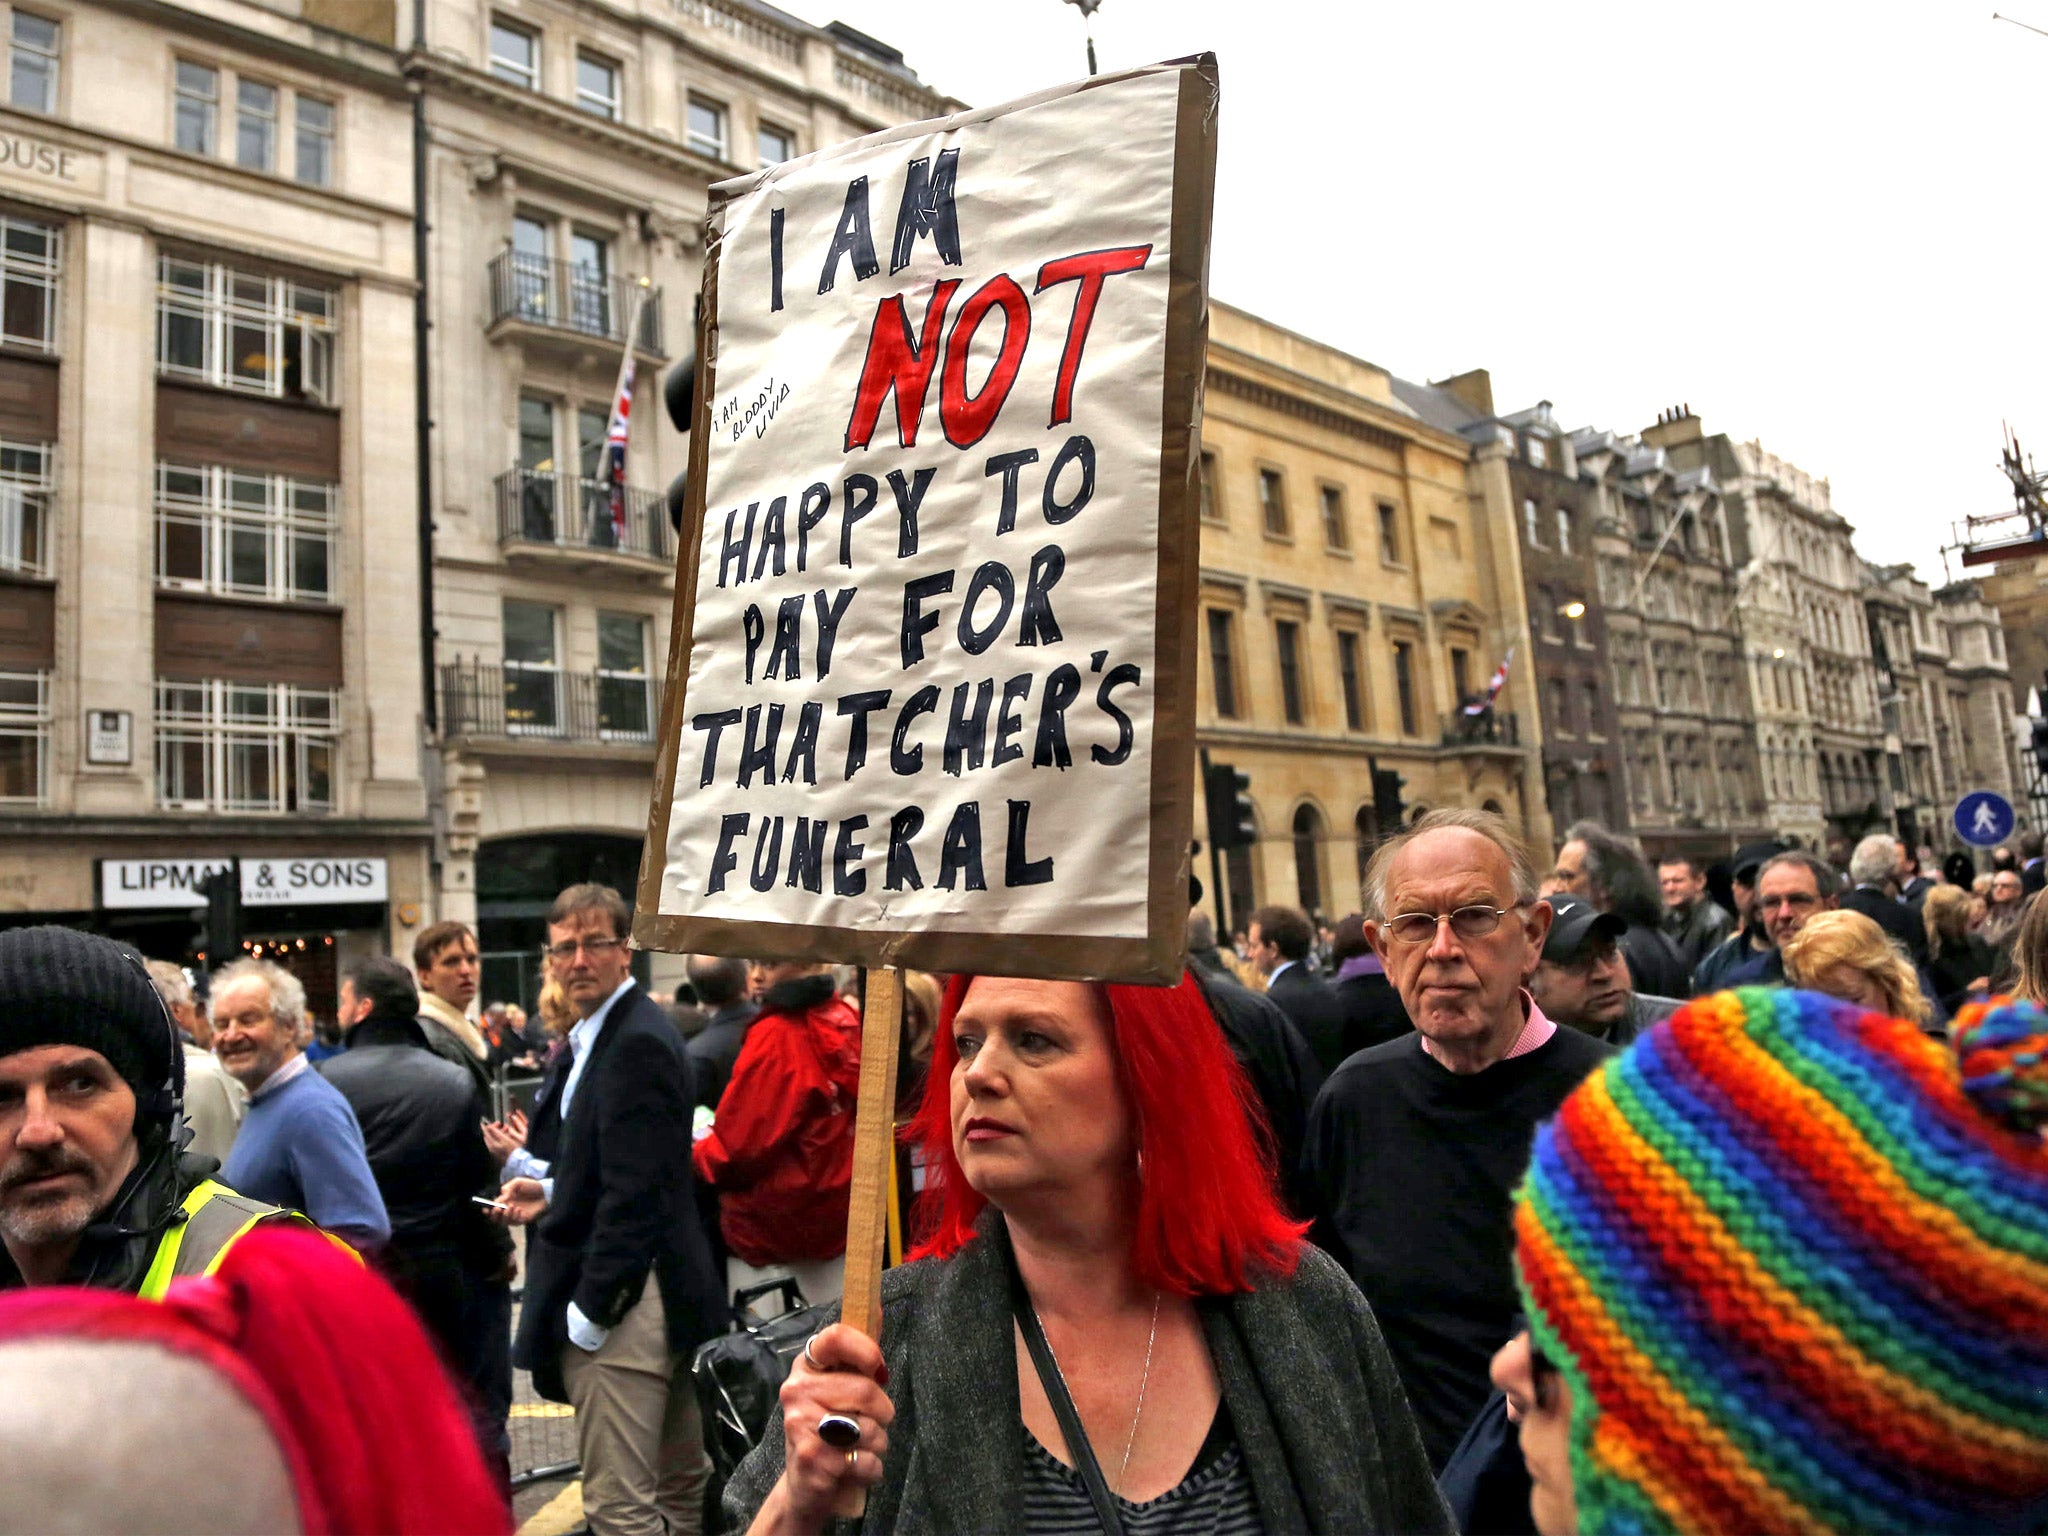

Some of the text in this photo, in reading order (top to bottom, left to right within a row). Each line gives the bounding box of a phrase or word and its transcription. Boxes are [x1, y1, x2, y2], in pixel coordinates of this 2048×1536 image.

[770, 147, 962, 313] I AM
[722, 395, 738, 425] AM
[732, 376, 774, 442] BLOODY
[843, 243, 1154, 454] NOT
[716, 435, 1097, 589] HAPPY TO
[743, 544, 1066, 686] PAY FOR
[691, 649, 1142, 790] THATCHER'S
[121, 862, 374, 891] LIPMA & SONS
[704, 798, 1055, 898] FUNERAL
